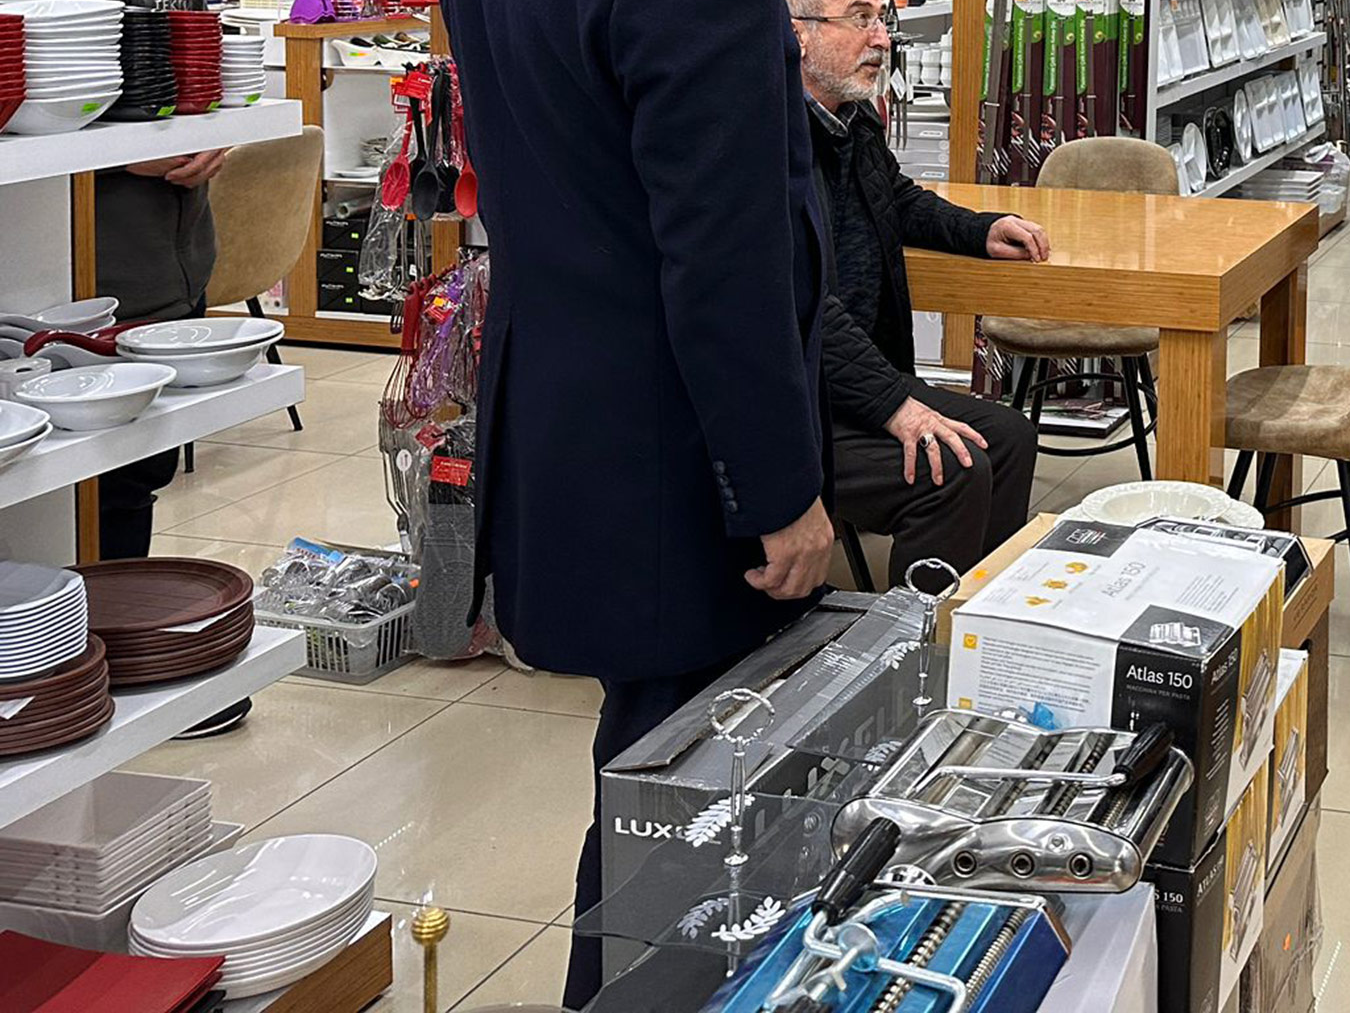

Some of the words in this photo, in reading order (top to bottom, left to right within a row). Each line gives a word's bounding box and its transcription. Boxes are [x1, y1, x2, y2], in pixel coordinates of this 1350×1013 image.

[1126, 664, 1164, 684] Atlas
[1167, 670, 1193, 690] 150
[1163, 890, 1184, 904] 150
